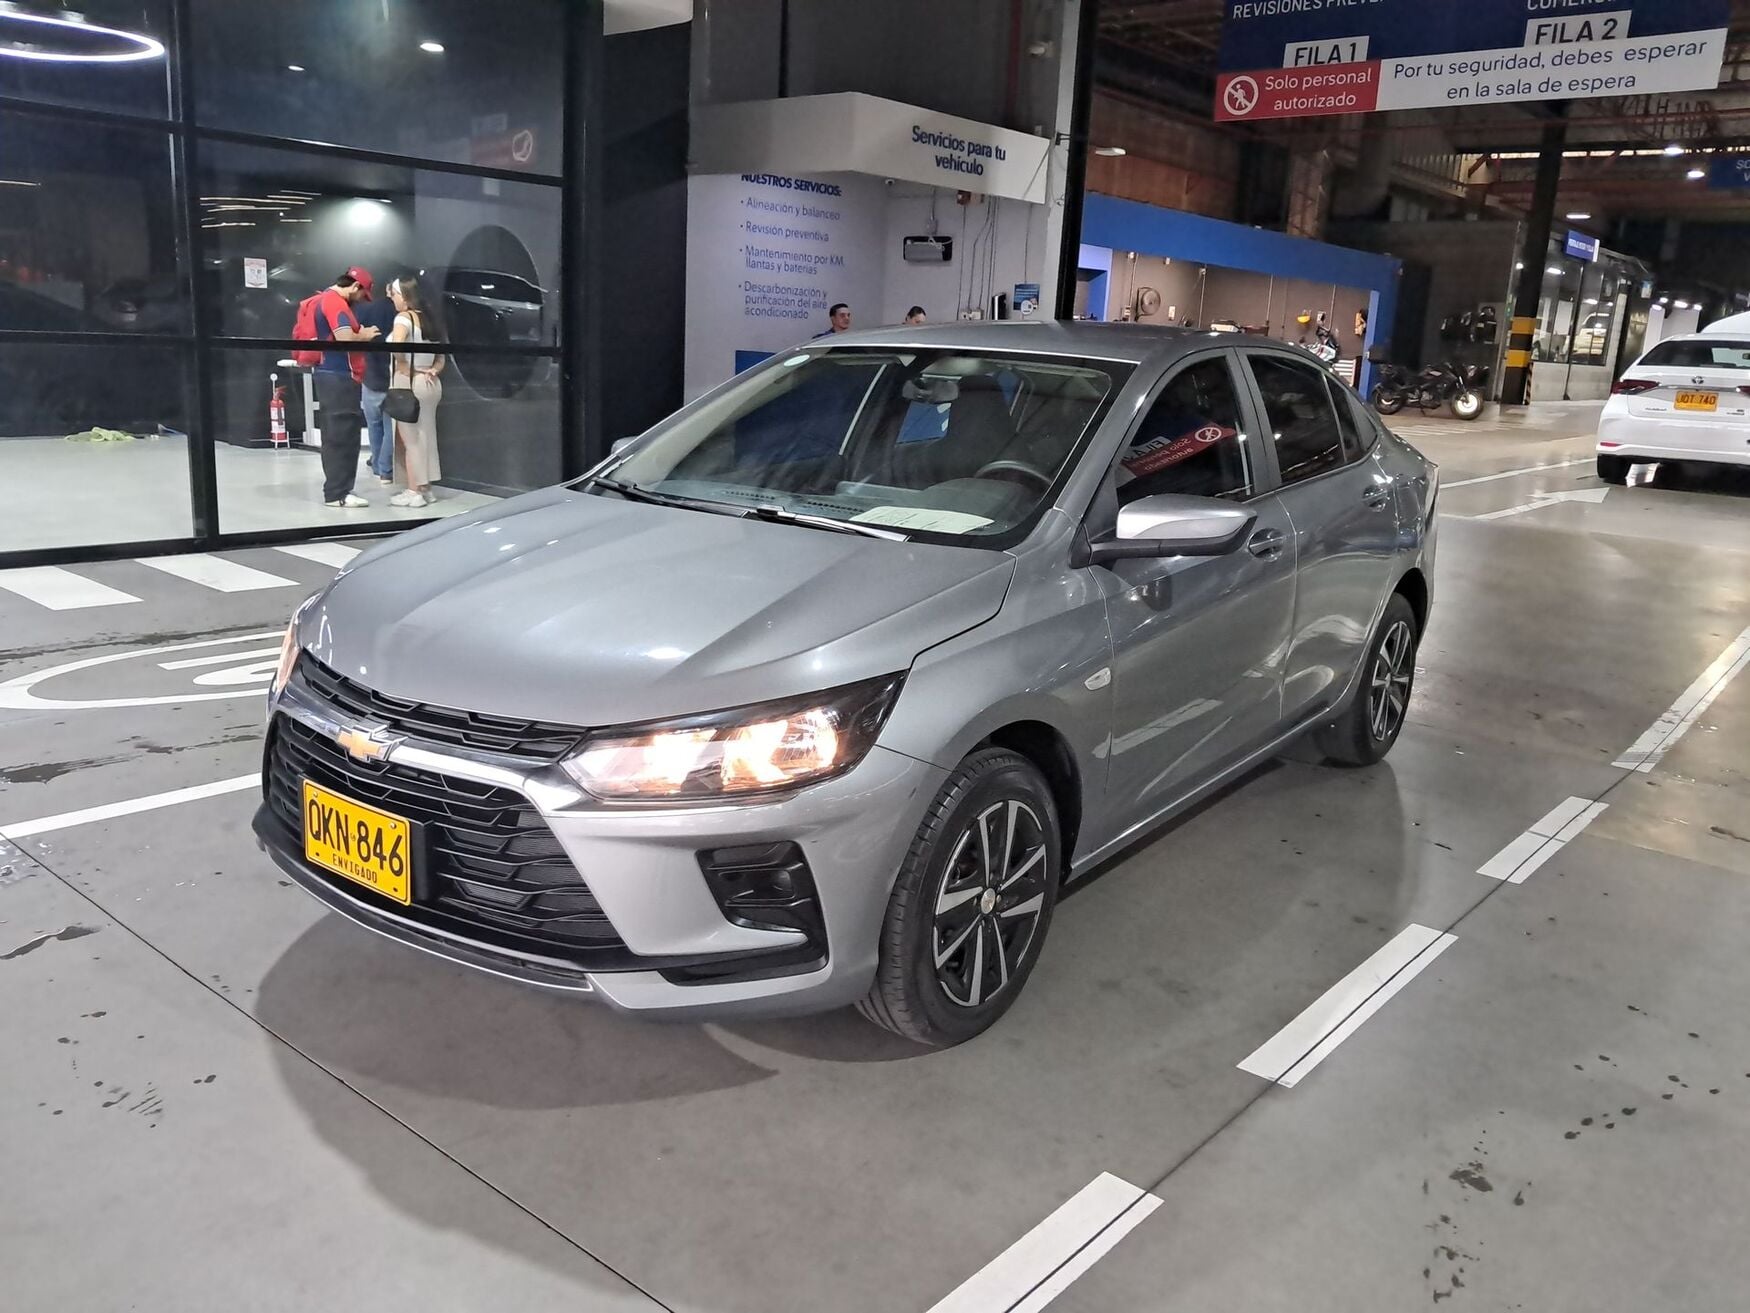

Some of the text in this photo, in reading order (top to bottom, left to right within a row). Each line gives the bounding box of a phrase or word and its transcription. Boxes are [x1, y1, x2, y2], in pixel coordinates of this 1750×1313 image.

[1232, 0, 1322, 19] REVISIONES
[1535, 18, 1618, 45] FILA 2
[1294, 42, 1357, 66] FILA 1
[1394, 41, 1708, 79] Por tu seguridad, debes esperar
[1265, 68, 1372, 91] Solo personal
[1447, 75, 1636, 99] en la sala de espera
[1273, 92, 1357, 111] autorizado
[912, 125, 1006, 161] Servicios para tu
[741, 174, 842, 196] NUESTROS SERVICIOS:
[795, 208, 801, 217] y
[802, 205, 841, 220] balanceo
[785, 228, 829, 242] preventiva
[745, 245, 812, 263] Mantenimiento
[814, 255, 828, 265] por
[745, 258, 775, 271] llantas
[776, 264, 782, 273] y
[797, 298, 810, 308] del
[812, 299, 828, 310] aire
[822, 290, 828, 299] y
[745, 306, 809, 319] acondicionado
[1698, 394, 1716, 405] 740
[309, 798, 404, 877] QKN 846
[332, 853, 378, 884] ENVIGADO
